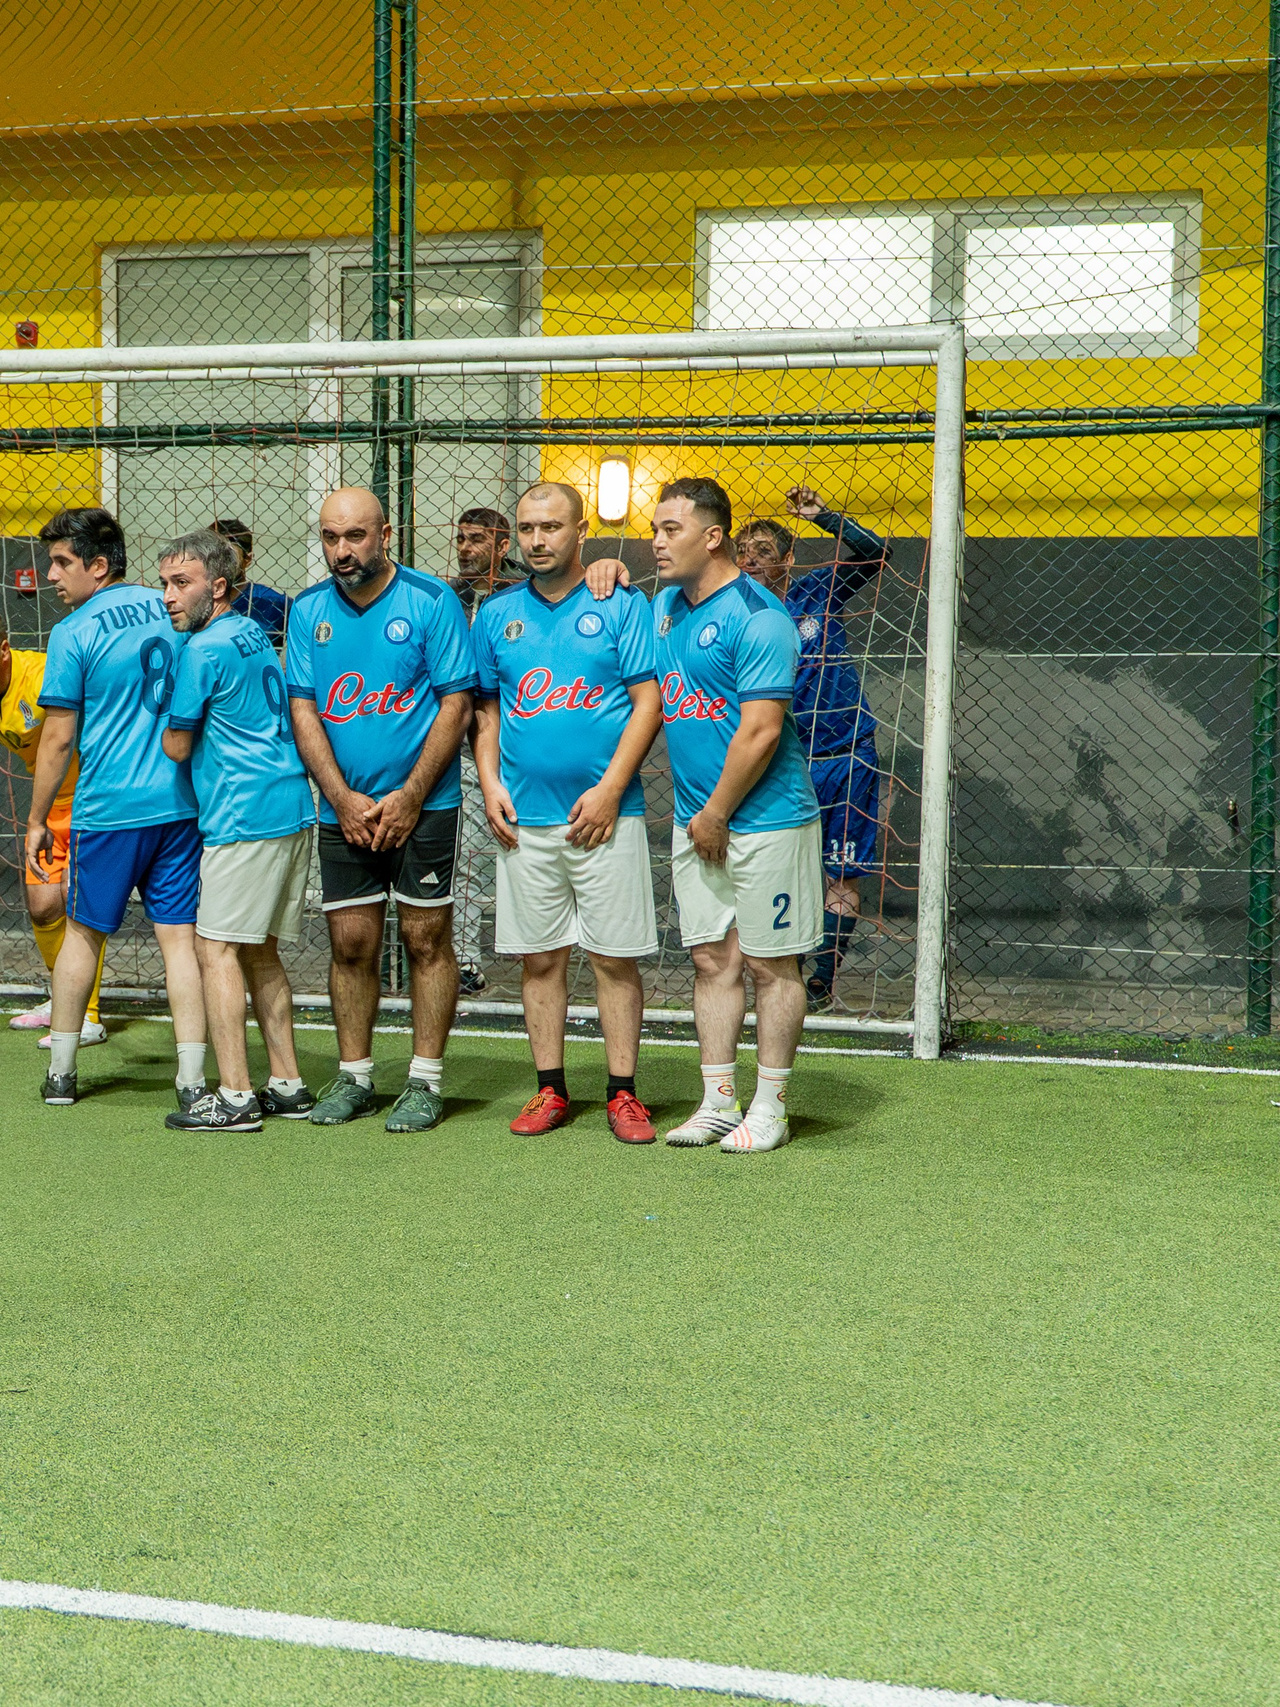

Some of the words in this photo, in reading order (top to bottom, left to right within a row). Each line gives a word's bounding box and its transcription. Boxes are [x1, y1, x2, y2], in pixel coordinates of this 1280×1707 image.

[391, 623, 405, 638] N
[583, 618, 596, 631] N
[140, 636, 175, 717] 8
[318, 671, 416, 725] Lete
[509, 667, 605, 720] Lete
[660, 671, 728, 724] Lete
[262, 664, 295, 744] 9
[829, 839, 856, 864] 10
[772, 892, 792, 931] 2
